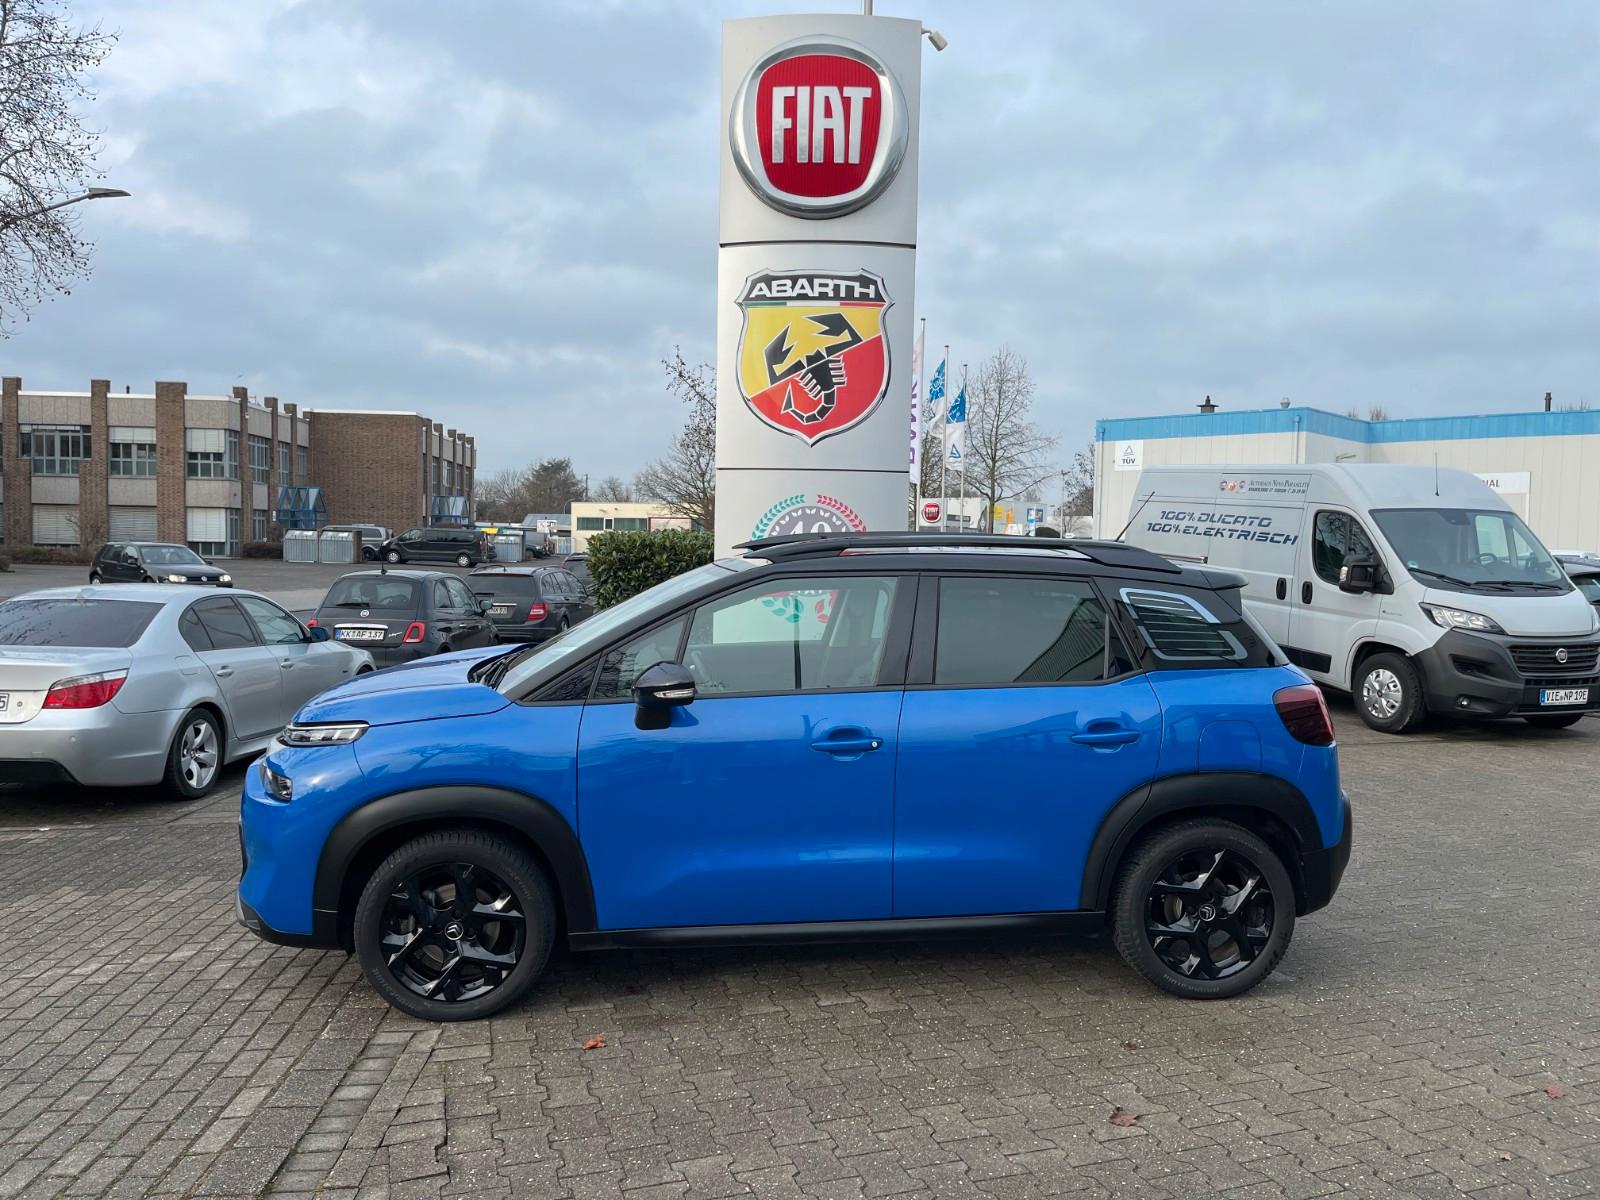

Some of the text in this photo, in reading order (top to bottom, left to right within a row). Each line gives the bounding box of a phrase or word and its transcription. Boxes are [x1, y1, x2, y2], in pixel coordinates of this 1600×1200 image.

[772, 86, 872, 164] FIAT
[749, 278, 875, 299] ABARTH
[1160, 510, 1272, 528] 100% DUCATO
[1147, 522, 1299, 545] 100% ELEKTRISCH
[341, 630, 351, 638] KK
[356, 630, 367, 638] AF
[1547, 690, 1588, 702] VIE NP 19E
